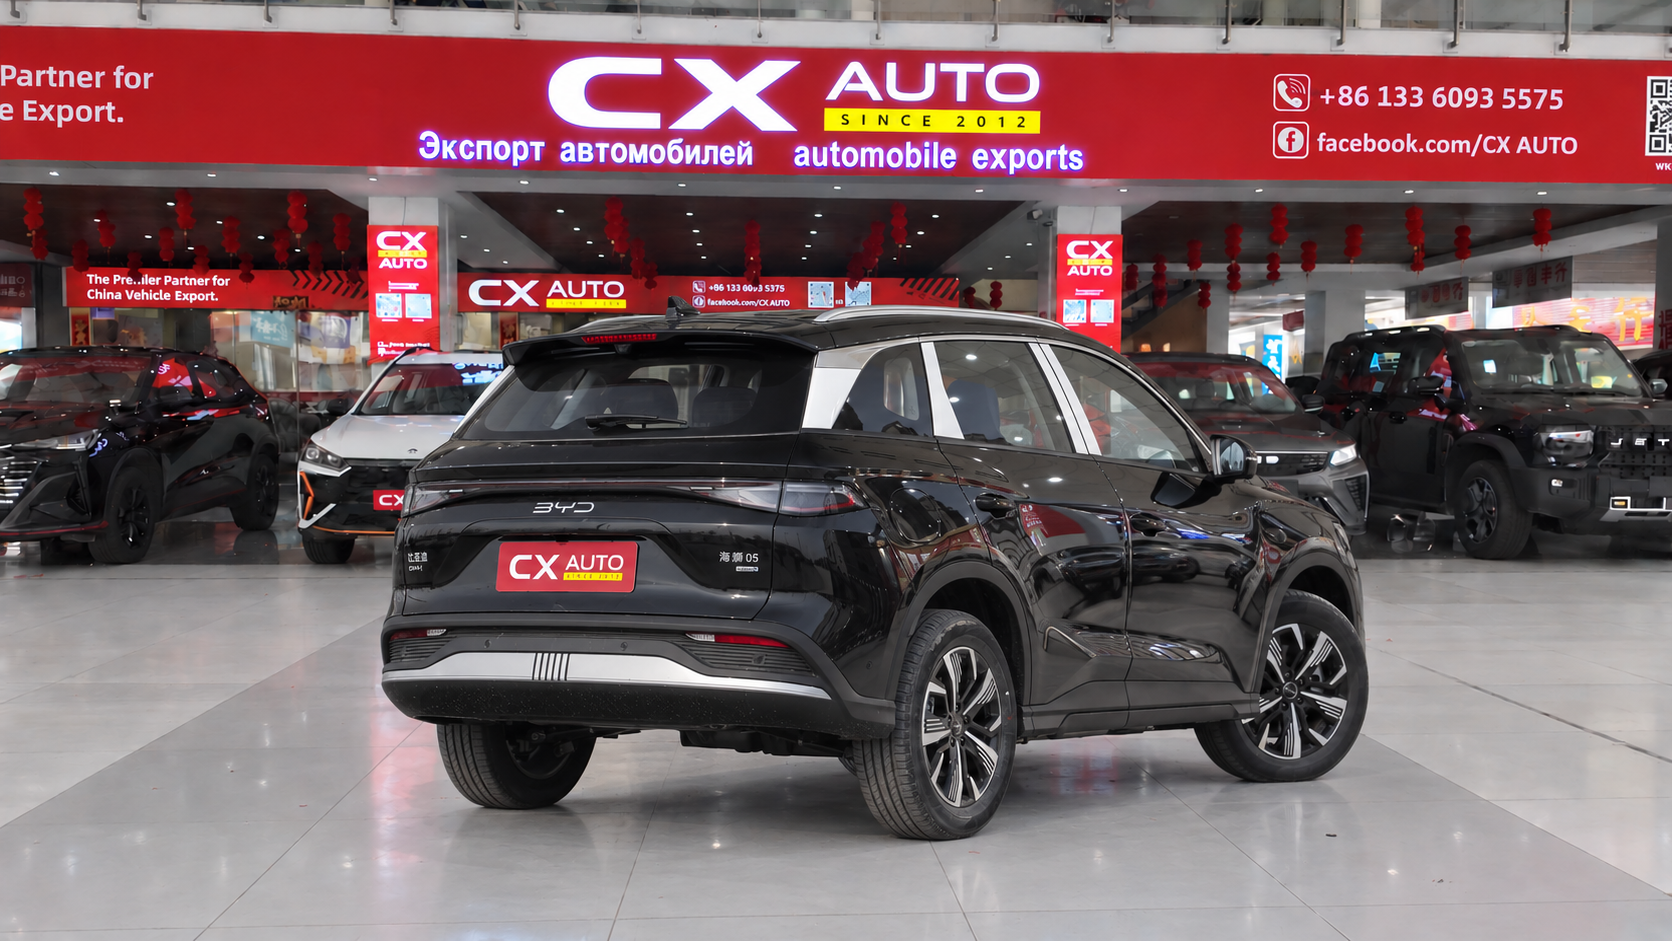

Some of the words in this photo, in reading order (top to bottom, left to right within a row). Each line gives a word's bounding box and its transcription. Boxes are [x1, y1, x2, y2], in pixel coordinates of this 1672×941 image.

[0, 64, 105, 88] Partner
[113, 65, 153, 89] for
[548, 57, 800, 131] CX
[826, 62, 1039, 103] AUTO
[1321, 86, 1368, 107] +86
[1378, 86, 1423, 107] 133
[1433, 87, 1493, 109] 6093
[1502, 88, 1564, 109] 5575
[24, 99, 123, 127] Export.
[842, 113, 931, 127] SINCE
[957, 115, 1026, 128] 2012
[418, 130, 546, 167] Экспорт
[559, 137, 754, 166] автомобилей
[1317, 132, 1510, 157] facebook.com/CX
[1516, 137, 1578, 155] AUTO
[794, 141, 957, 170] automobile
[972, 145, 1084, 174] exports
[377, 231, 427, 250] CX
[1066, 240, 1113, 257] CX
[379, 257, 428, 269] AUTO
[1067, 262, 1113, 276] AUTO
[86, 273, 110, 285] The
[164, 275, 210, 287] Partner
[212, 275, 231, 287] for
[86, 288, 123, 300] China
[125, 288, 172, 301] Vehicle
[174, 290, 219, 304] Export.
[468, 279, 540, 307] CX
[547, 281, 625, 298] AUTO
[533, 501, 595, 514] BYD
[509, 554, 560, 580] CX
[565, 554, 624, 571] AUTO
